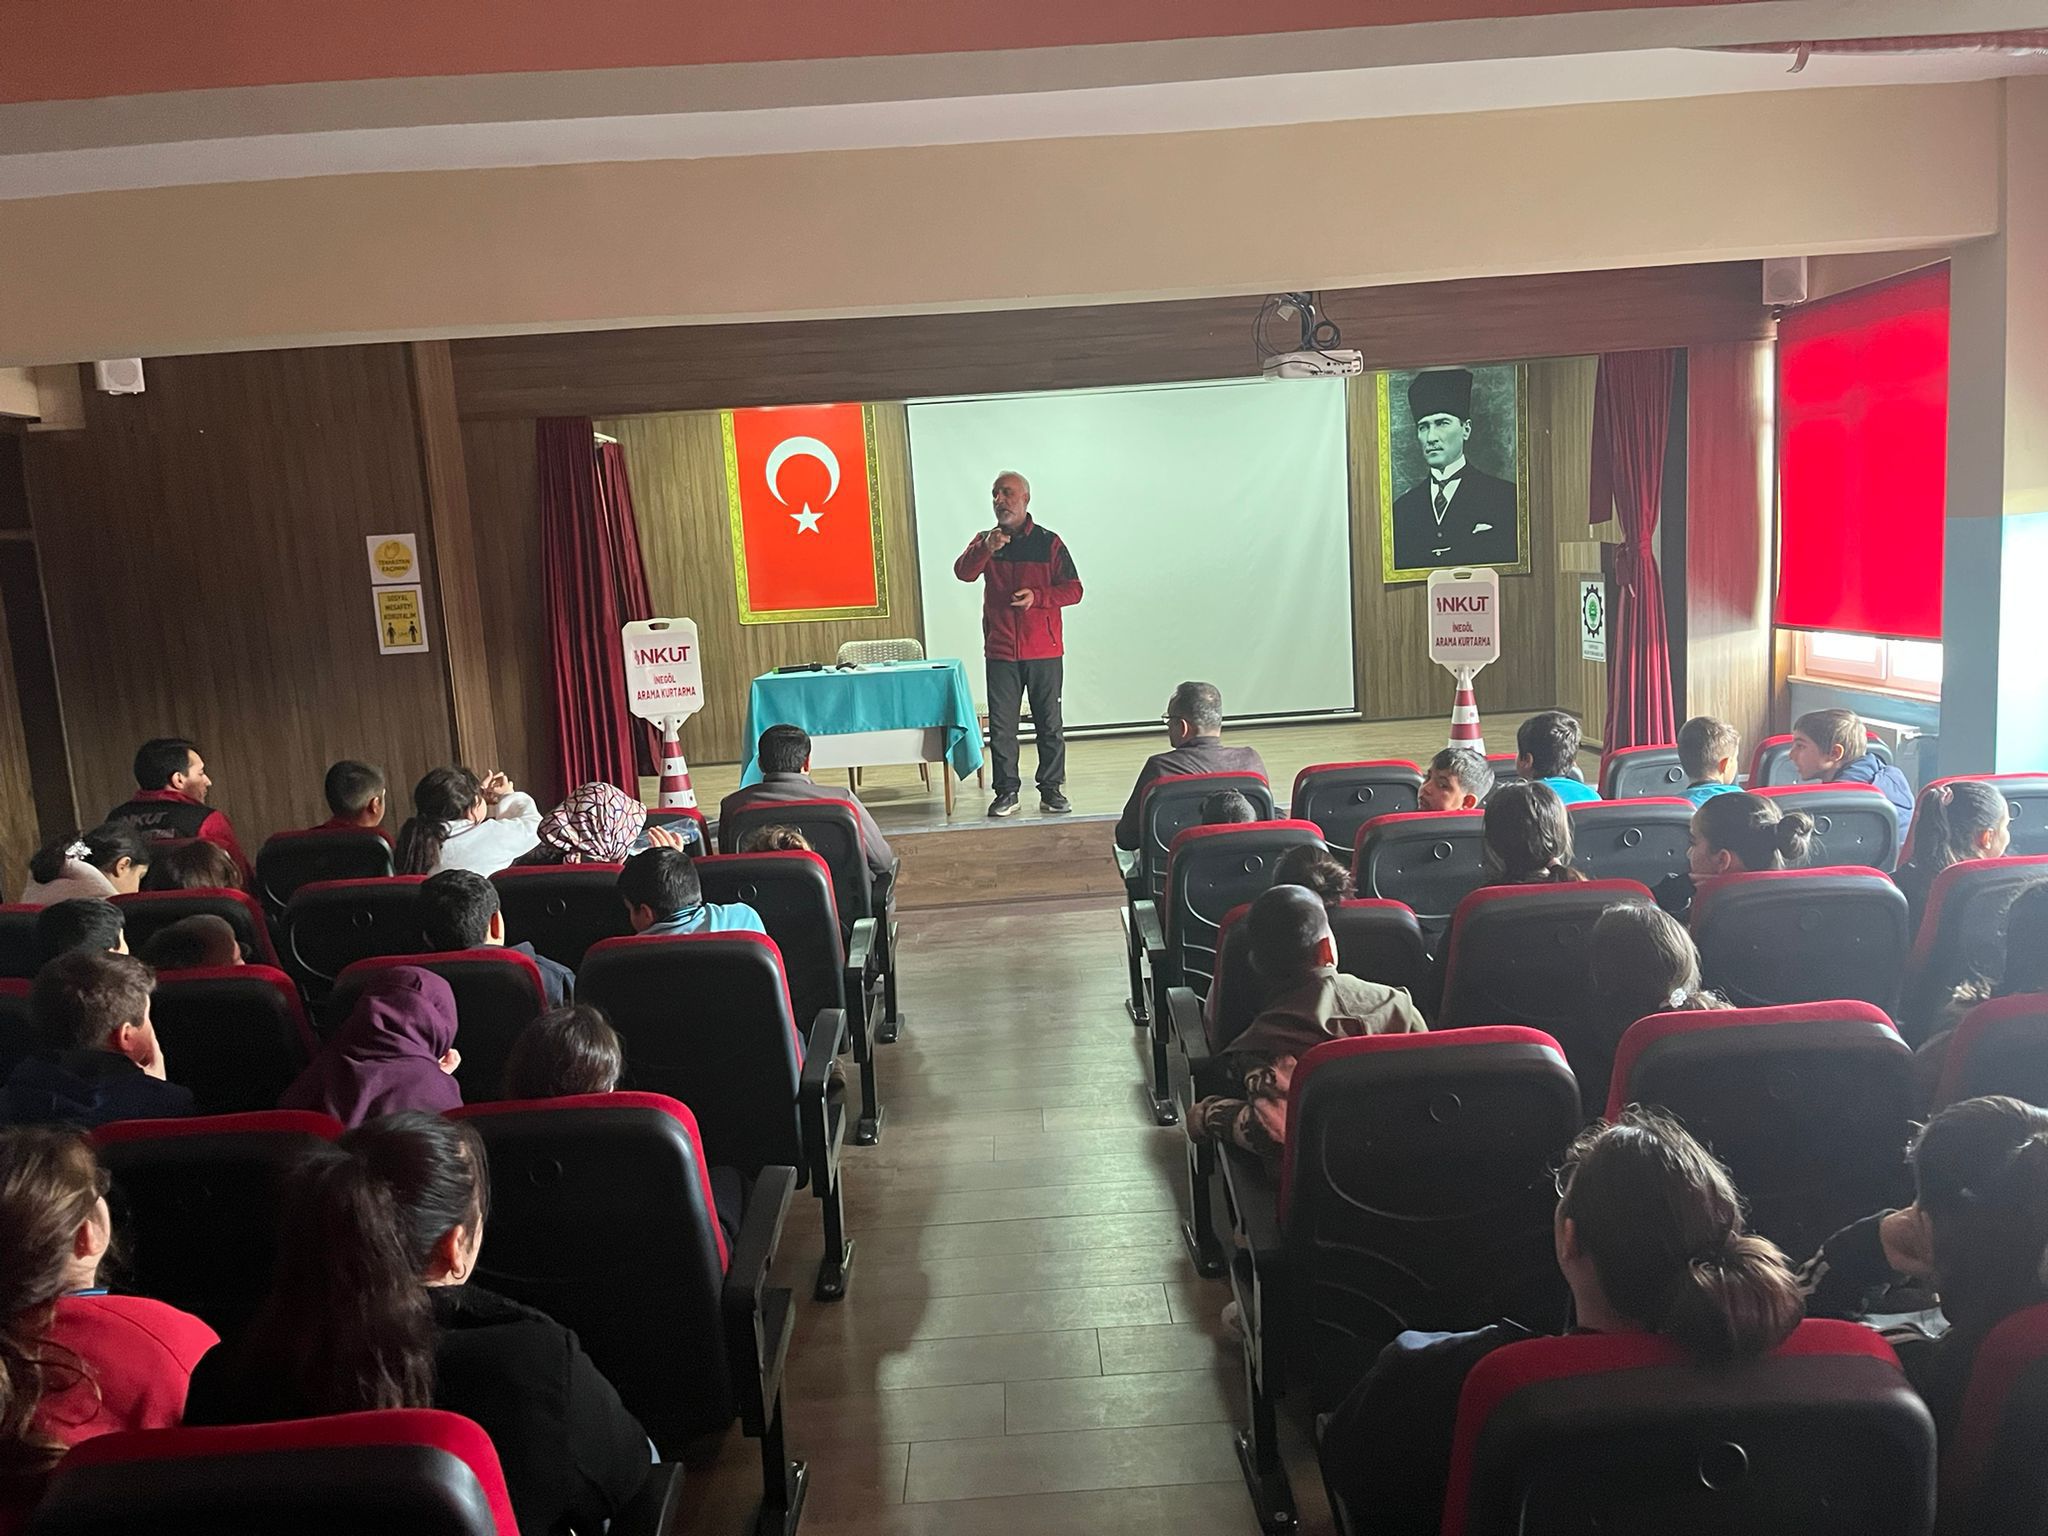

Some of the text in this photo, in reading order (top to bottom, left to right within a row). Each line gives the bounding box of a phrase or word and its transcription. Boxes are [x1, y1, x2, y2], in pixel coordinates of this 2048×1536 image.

[1435, 636, 1490, 647] ARAMA KURTARMA
[637, 686, 696, 700] ARAMA KURTARMA
